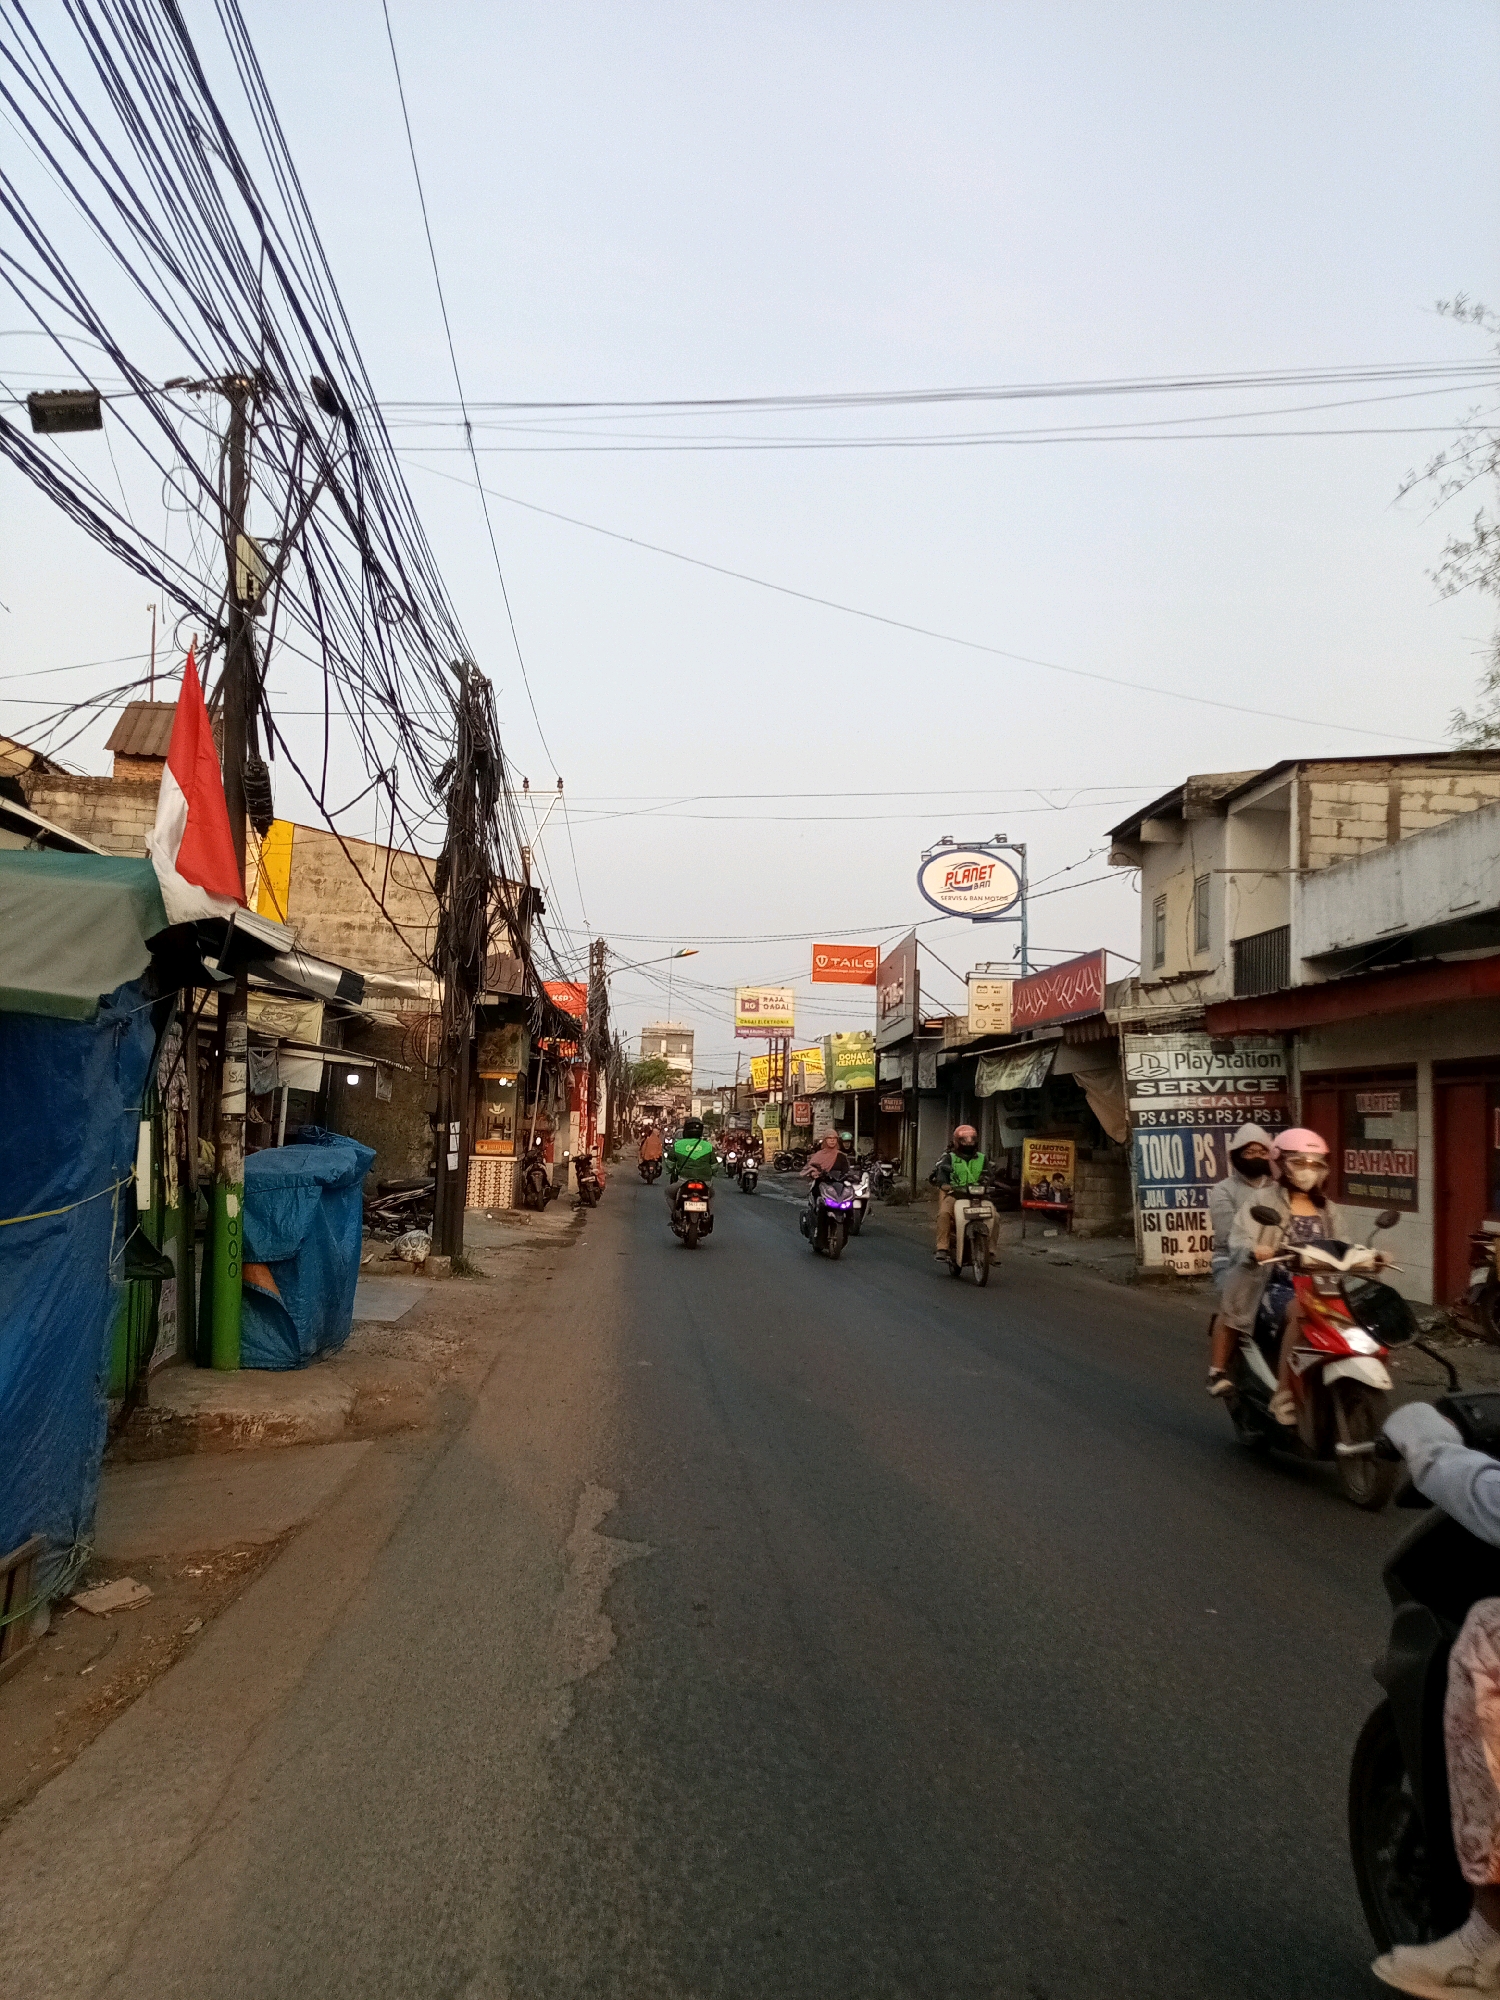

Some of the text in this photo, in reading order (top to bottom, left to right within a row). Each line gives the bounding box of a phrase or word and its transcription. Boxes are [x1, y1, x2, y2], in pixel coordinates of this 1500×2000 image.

[945, 864, 996, 886] PLANET
[973, 880, 991, 890] BAN
[830, 957, 875, 968] TAILG
[836, 1058, 874, 1067] KENTANG
[838, 1052, 867, 1061] DONAT
[1174, 1051, 1282, 1076] PlayStation
[1136, 1079, 1280, 1096] SERVICE
[1138, 1109, 1282, 1126] PS 4 PS 5 PS 2 PS 3
[1031, 1153, 1050, 1165] 2X
[1138, 1134, 1186, 1180] TOKO
[1192, 1133, 1217, 1178] PS
[1344, 1149, 1415, 1178] BAHARI
[1144, 1189, 1168, 1208] JUAL
[1175, 1188, 1188, 1207] PS
[1189, 1188, 1197, 1206] 2
[1142, 1211, 1207, 1232] ISI GAME
[1161, 1235, 1183, 1256] Rp.
